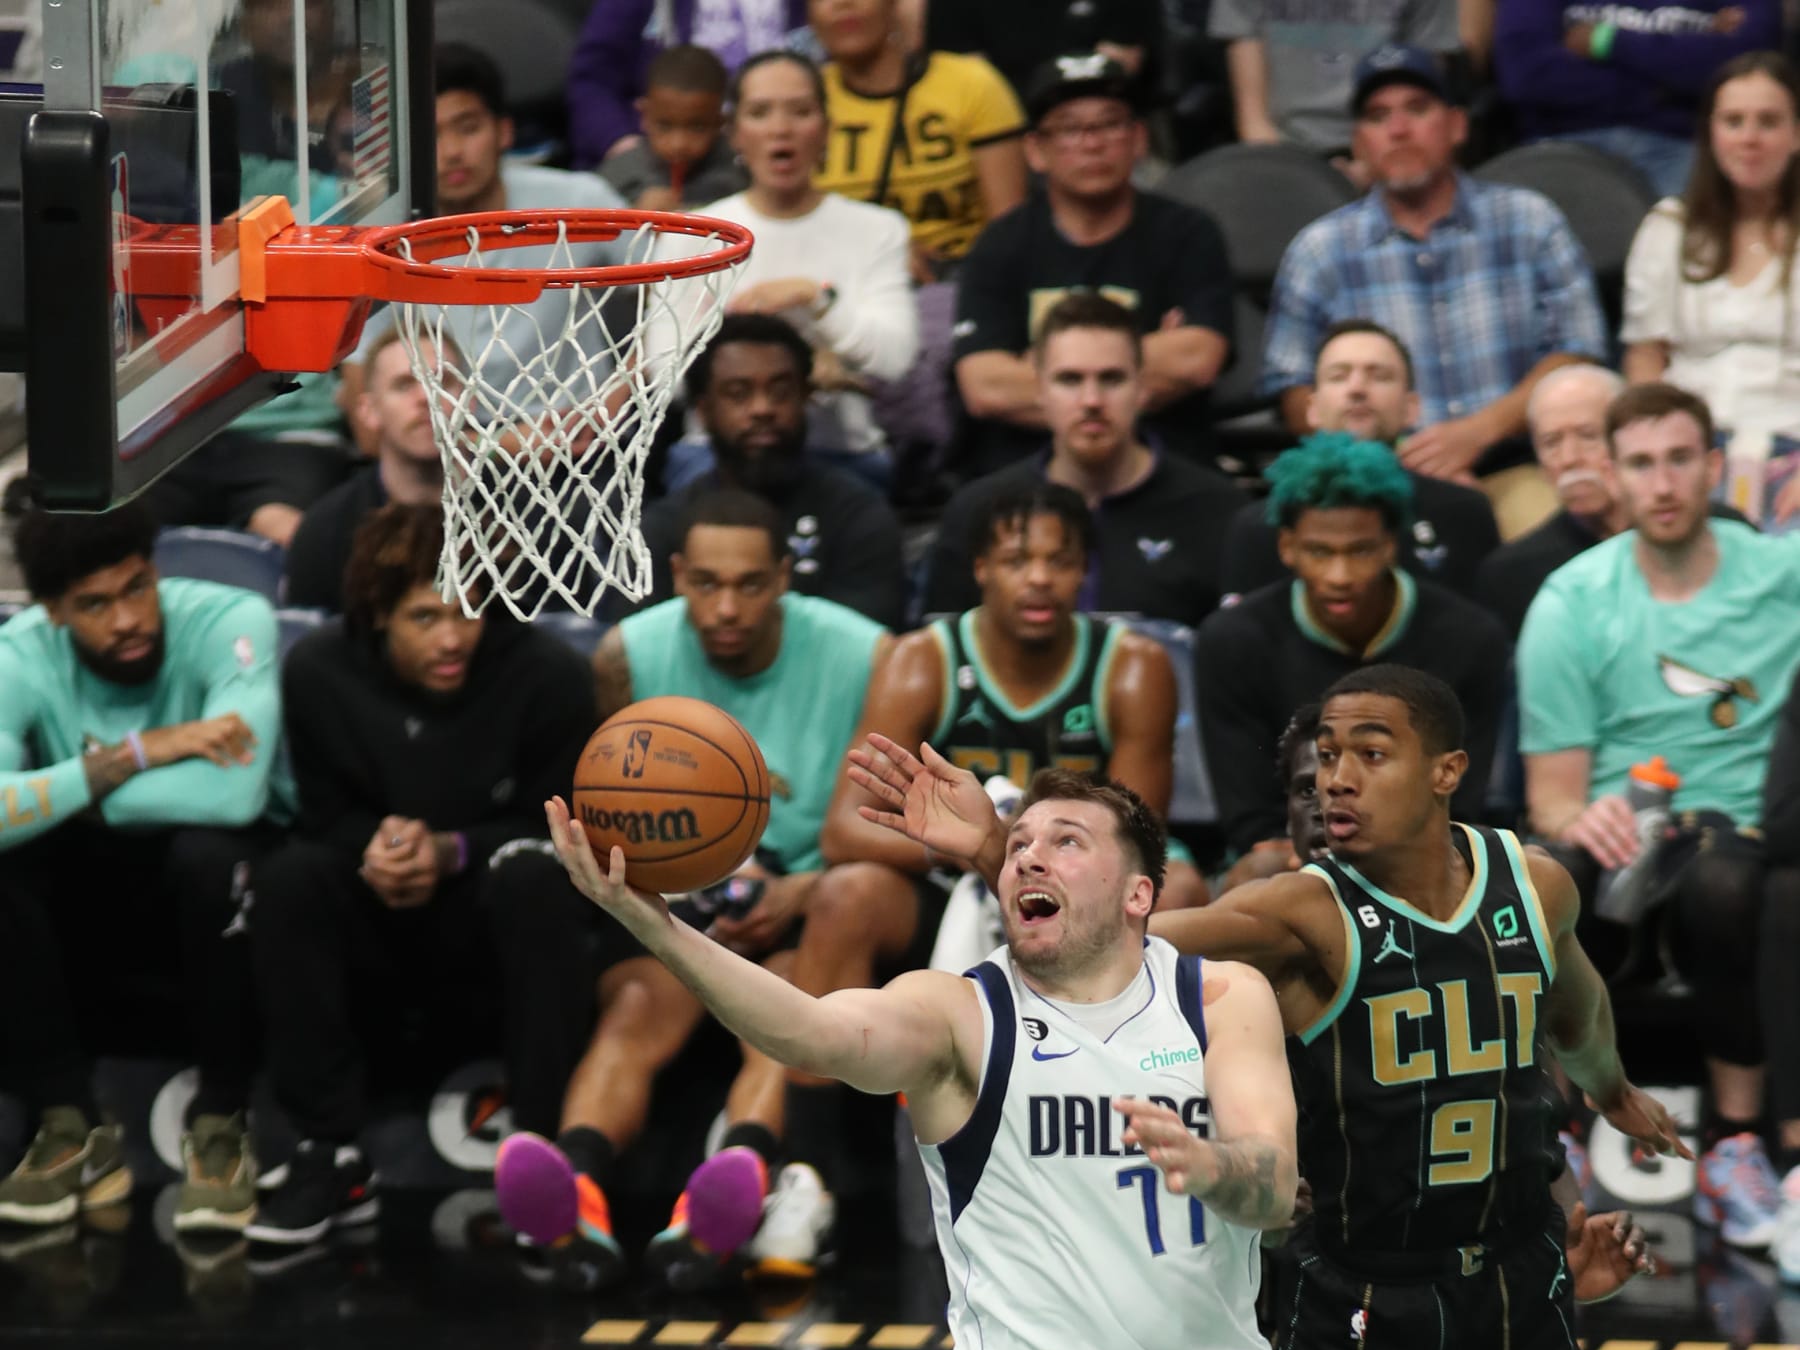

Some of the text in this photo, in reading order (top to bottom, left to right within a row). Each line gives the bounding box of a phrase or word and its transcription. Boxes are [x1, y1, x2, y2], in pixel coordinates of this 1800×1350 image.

[581, 803, 702, 844] Wilson
[1358, 904, 1381, 928] 6
[1361, 971, 1543, 1087] CLT
[1139, 1047, 1201, 1072] chime
[1428, 1099, 1497, 1186] 9
